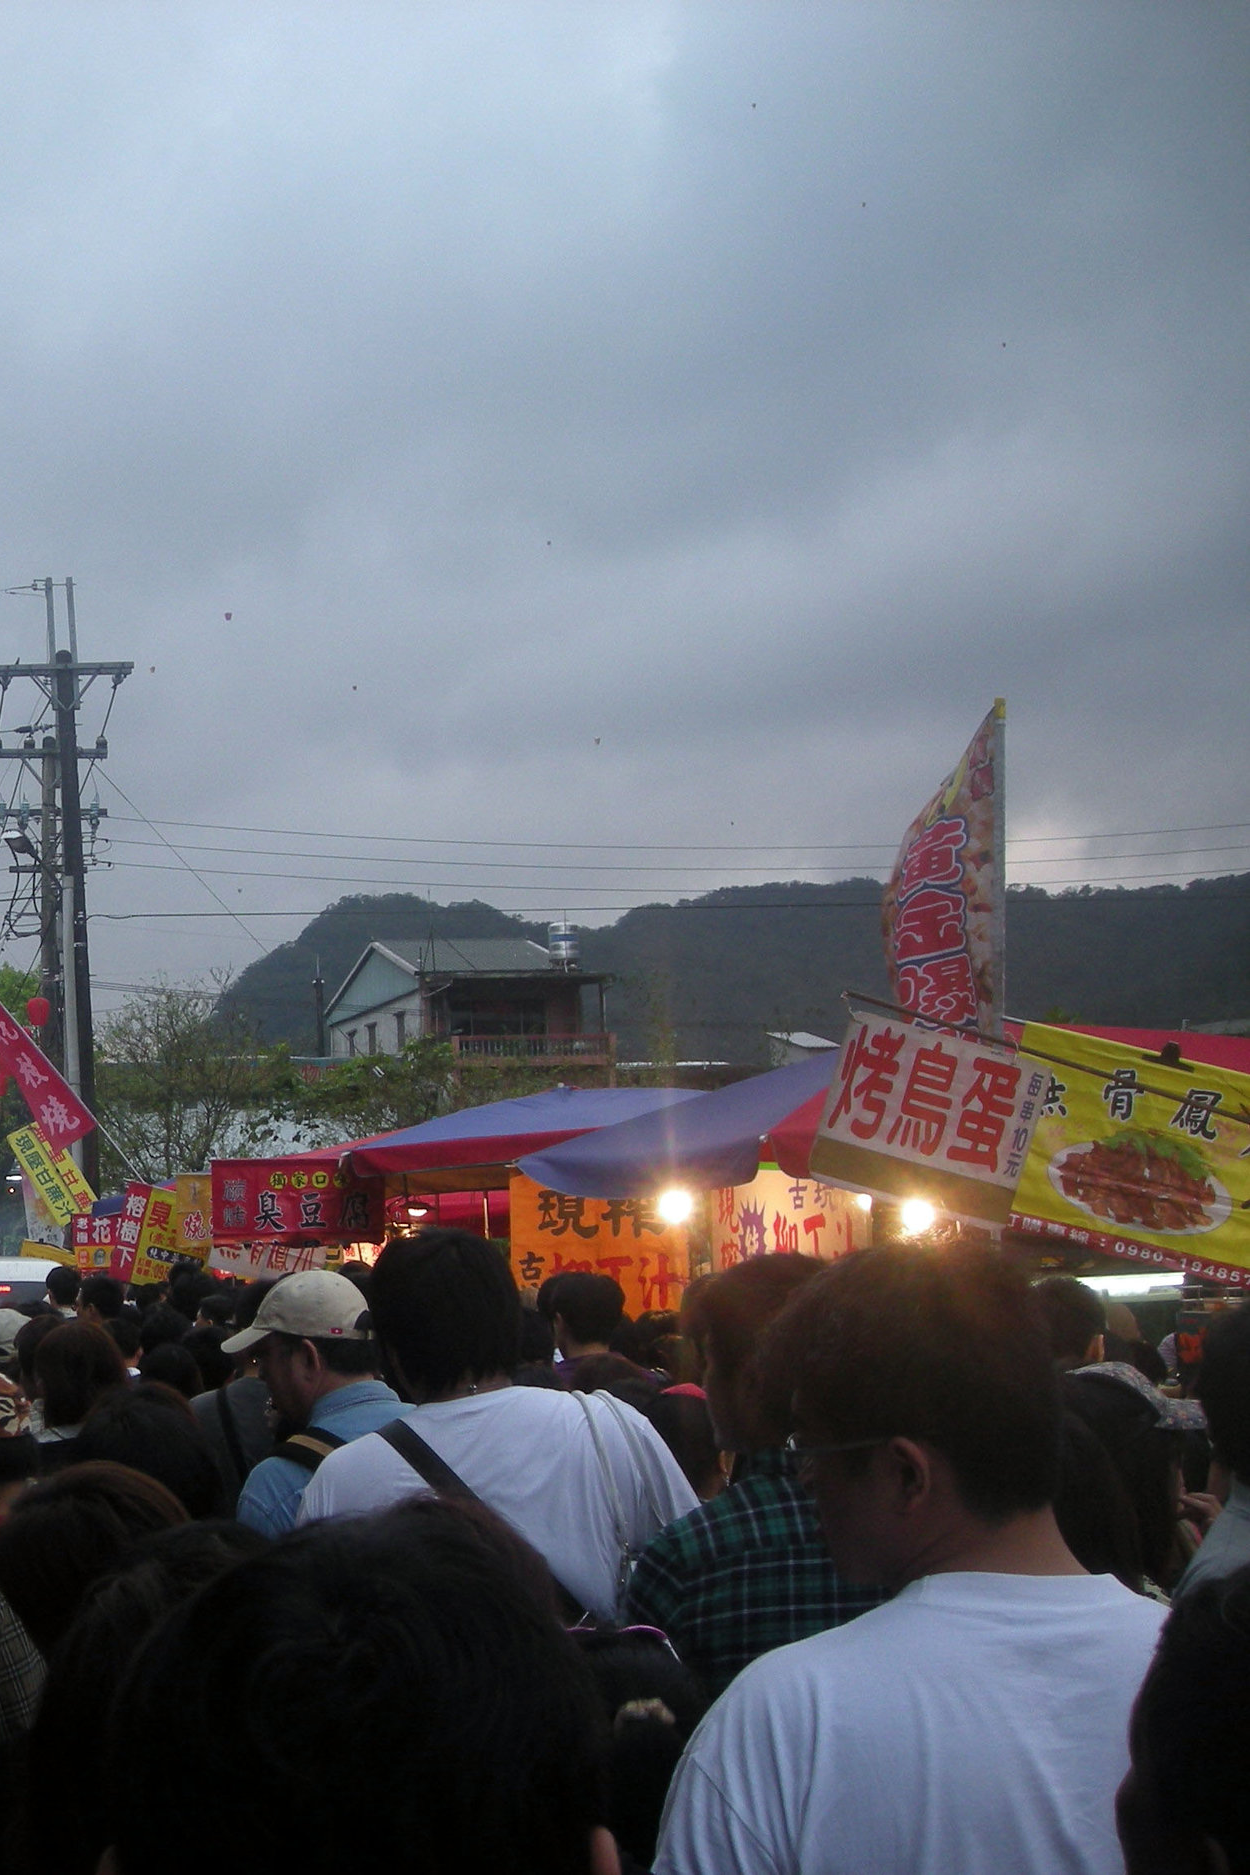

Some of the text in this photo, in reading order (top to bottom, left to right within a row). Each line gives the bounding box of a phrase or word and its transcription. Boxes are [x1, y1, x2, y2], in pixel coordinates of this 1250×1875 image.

[895, 816, 980, 1041] 黃金爆
[828, 1024, 1021, 1174] 烤鳥蛋
[1040, 1069, 1250, 1158] 無骨鳳
[15, 1133, 73, 1218] 現壓甘蔗汁
[254, 1190, 371, 1232] 臭豆腐
[117, 1195, 147, 1268] 榕樹下
[148, 1200, 177, 1233] 臭
[184, 1210, 213, 1240] 燒
